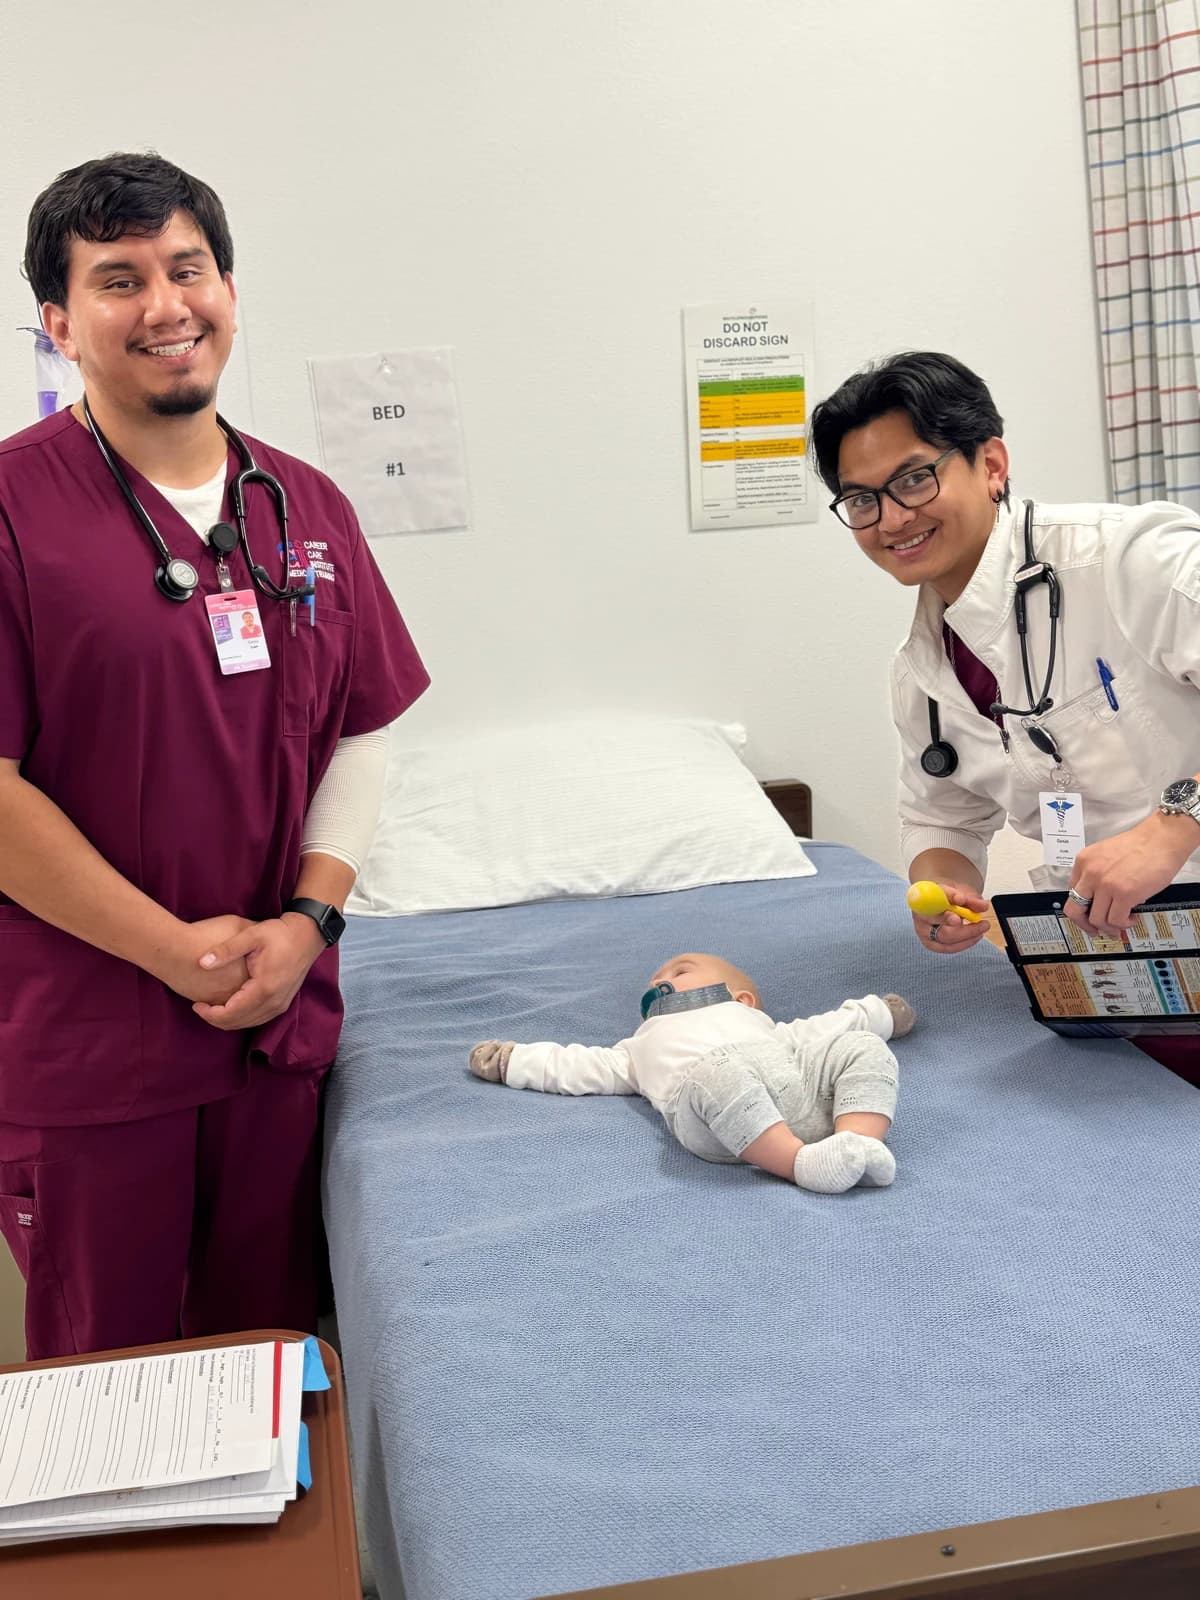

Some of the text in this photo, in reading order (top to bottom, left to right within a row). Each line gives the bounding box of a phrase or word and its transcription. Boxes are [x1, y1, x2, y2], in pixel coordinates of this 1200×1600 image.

[723, 322, 768, 333] DO NOT
[704, 335, 788, 348] DISCARD SIGN
[373, 405, 405, 420] BED
[386, 462, 406, 477] #1
[303, 541, 328, 550] CAREER
[307, 551, 323, 560] CARE
